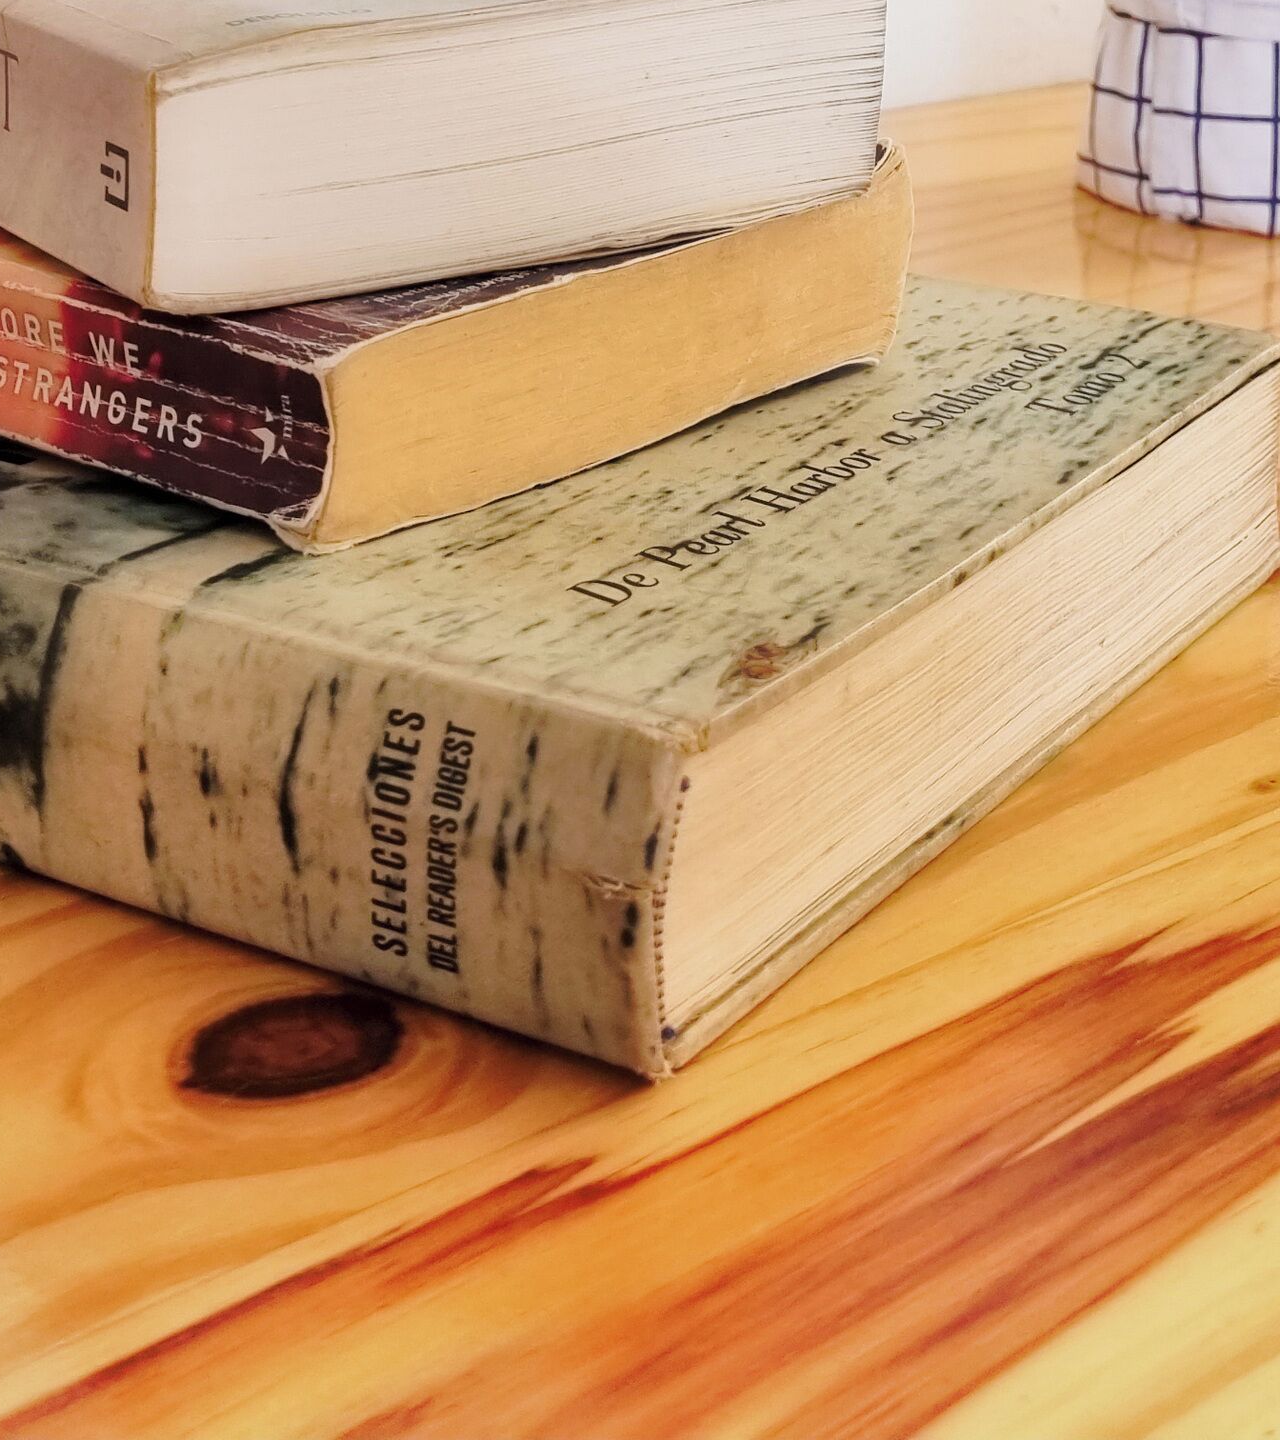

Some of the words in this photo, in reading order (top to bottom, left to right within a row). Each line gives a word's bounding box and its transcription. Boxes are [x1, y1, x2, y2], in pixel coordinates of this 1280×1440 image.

[88, 331, 139, 374] WE
[892, 342, 1067, 429] Stalingrado
[1025, 371, 1125, 417] Tomo
[880, 431, 917, 446] a
[740, 447, 882, 514] Harbor
[634, 510, 766, 571] Pearl
[566, 572, 659, 607] De
[431, 720, 476, 811] DIGEST
[370, 708, 426, 957] SELECCIONES
[426, 814, 459, 928] READER'S
[426, 934, 460, 974] DEL
